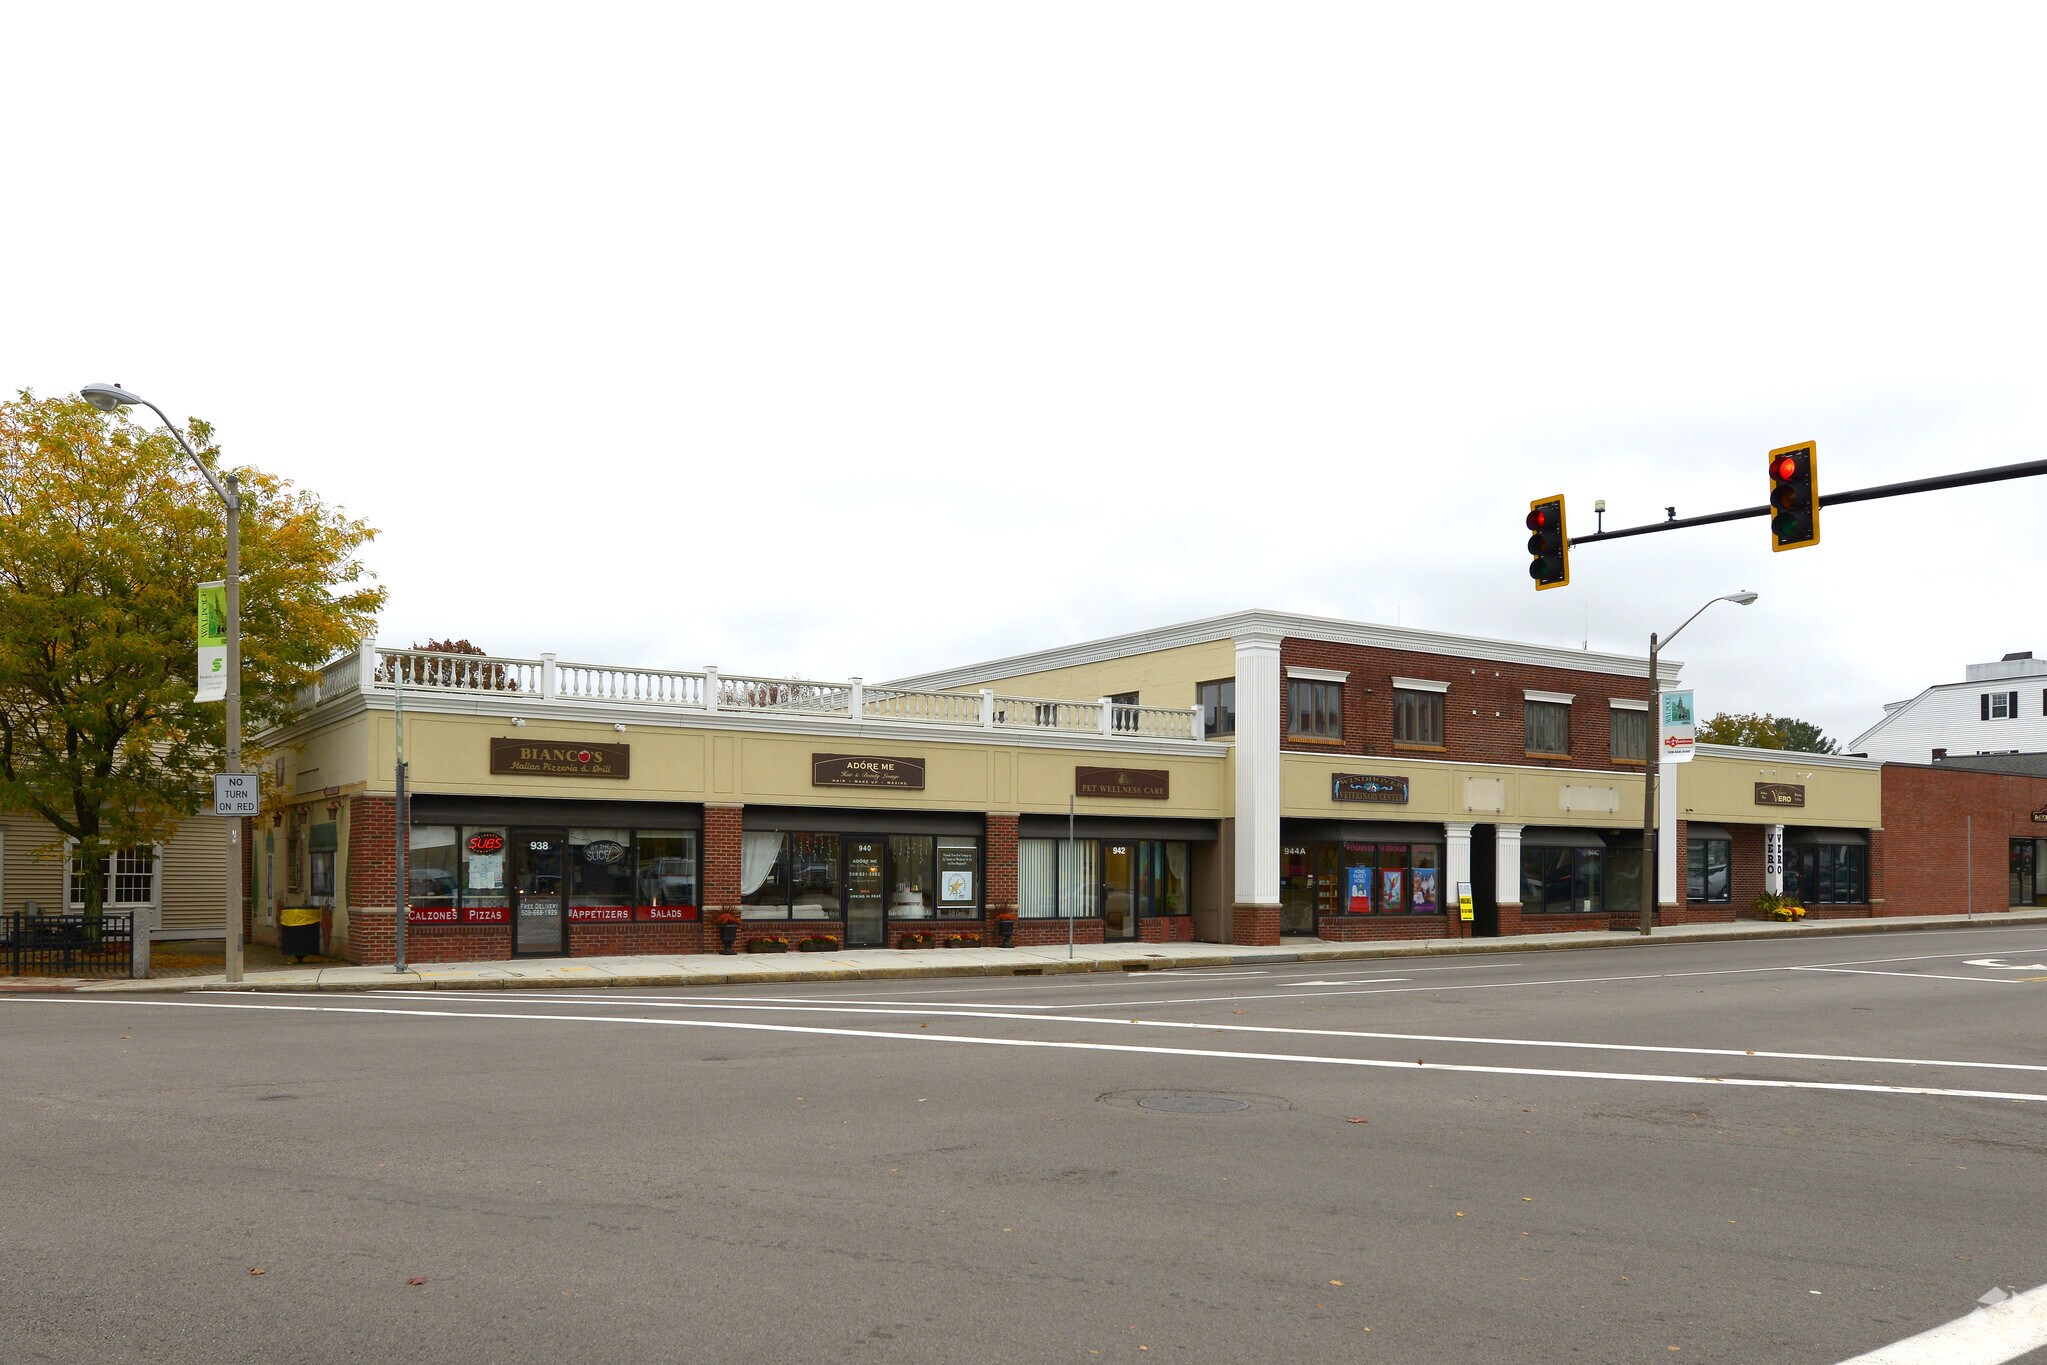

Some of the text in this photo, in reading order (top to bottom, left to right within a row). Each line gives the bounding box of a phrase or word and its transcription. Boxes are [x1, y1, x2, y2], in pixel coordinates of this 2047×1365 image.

[520, 748, 603, 763] BIANCO'S
[510, 762, 540, 770] Italian
[543, 763, 578, 772] Pizzeria
[592, 765, 611, 773] Grill
[881, 763, 895, 771] ME
[229, 778, 243, 786] NO
[1340, 776, 1404, 788] WINDHOVER
[225, 790, 248, 798] TURN
[1082, 784, 1165, 795] PET WELLNESS CARE
[1340, 791, 1404, 801] VETERINARY CENTER
[219, 802, 255, 811] ON RED
[468, 837, 503, 849] SUBS
[530, 841, 549, 850] 938
[858, 844, 872, 852] 940
[586, 850, 609, 861] SLICE
[1112, 846, 1126, 855] 942
[1284, 847, 1306, 855] 944A
[1767, 833, 1775, 875] VERO
[409, 911, 458, 920] CALZONES
[469, 910, 502, 920] PIZZAS
[571, 909, 629, 919] APPETIZERS
[650, 908, 682, 918] SALADS
